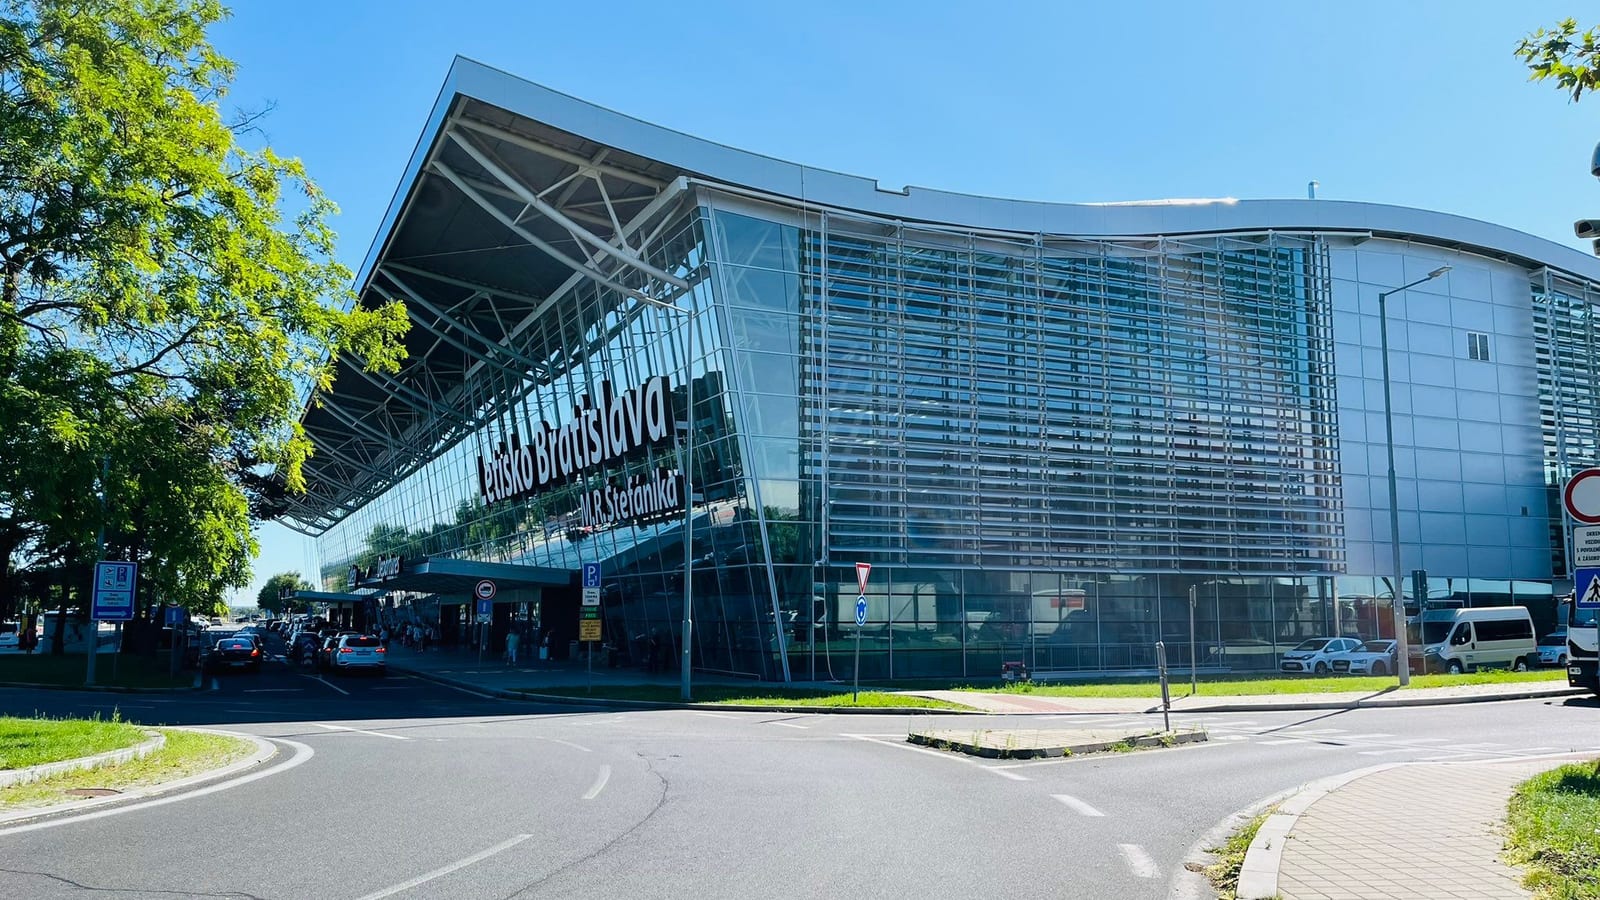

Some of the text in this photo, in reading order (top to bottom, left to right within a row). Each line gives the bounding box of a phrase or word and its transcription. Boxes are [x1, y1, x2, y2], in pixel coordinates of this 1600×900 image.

[477, 376, 669, 506] Letisko Bratislava
[588, 565, 596, 579] P
